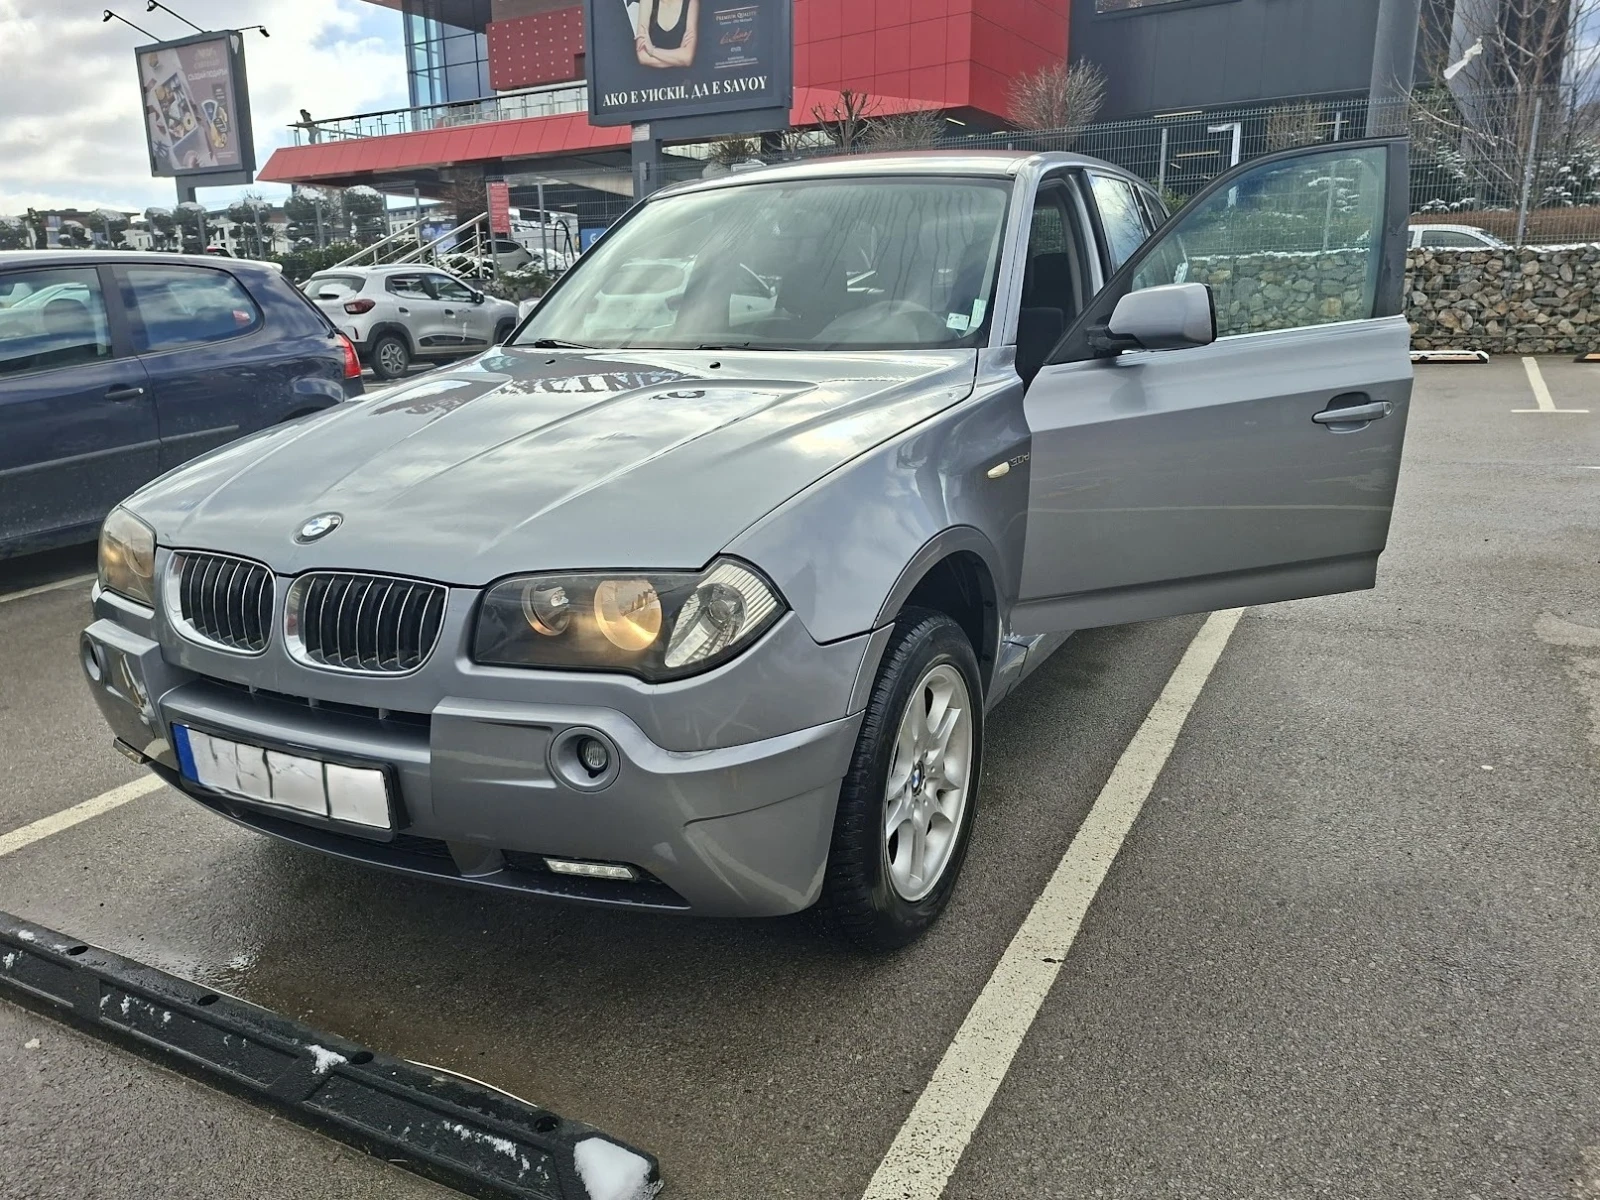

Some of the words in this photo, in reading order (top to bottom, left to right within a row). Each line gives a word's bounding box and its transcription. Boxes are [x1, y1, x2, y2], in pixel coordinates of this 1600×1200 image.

[603, 92, 628, 106] АКО
[630, 90, 639, 104] Е
[641, 86, 689, 103] УИСКИ,
[691, 83, 709, 99] ДА
[712, 80, 721, 95] Е
[723, 76, 767, 94] SAVOY
